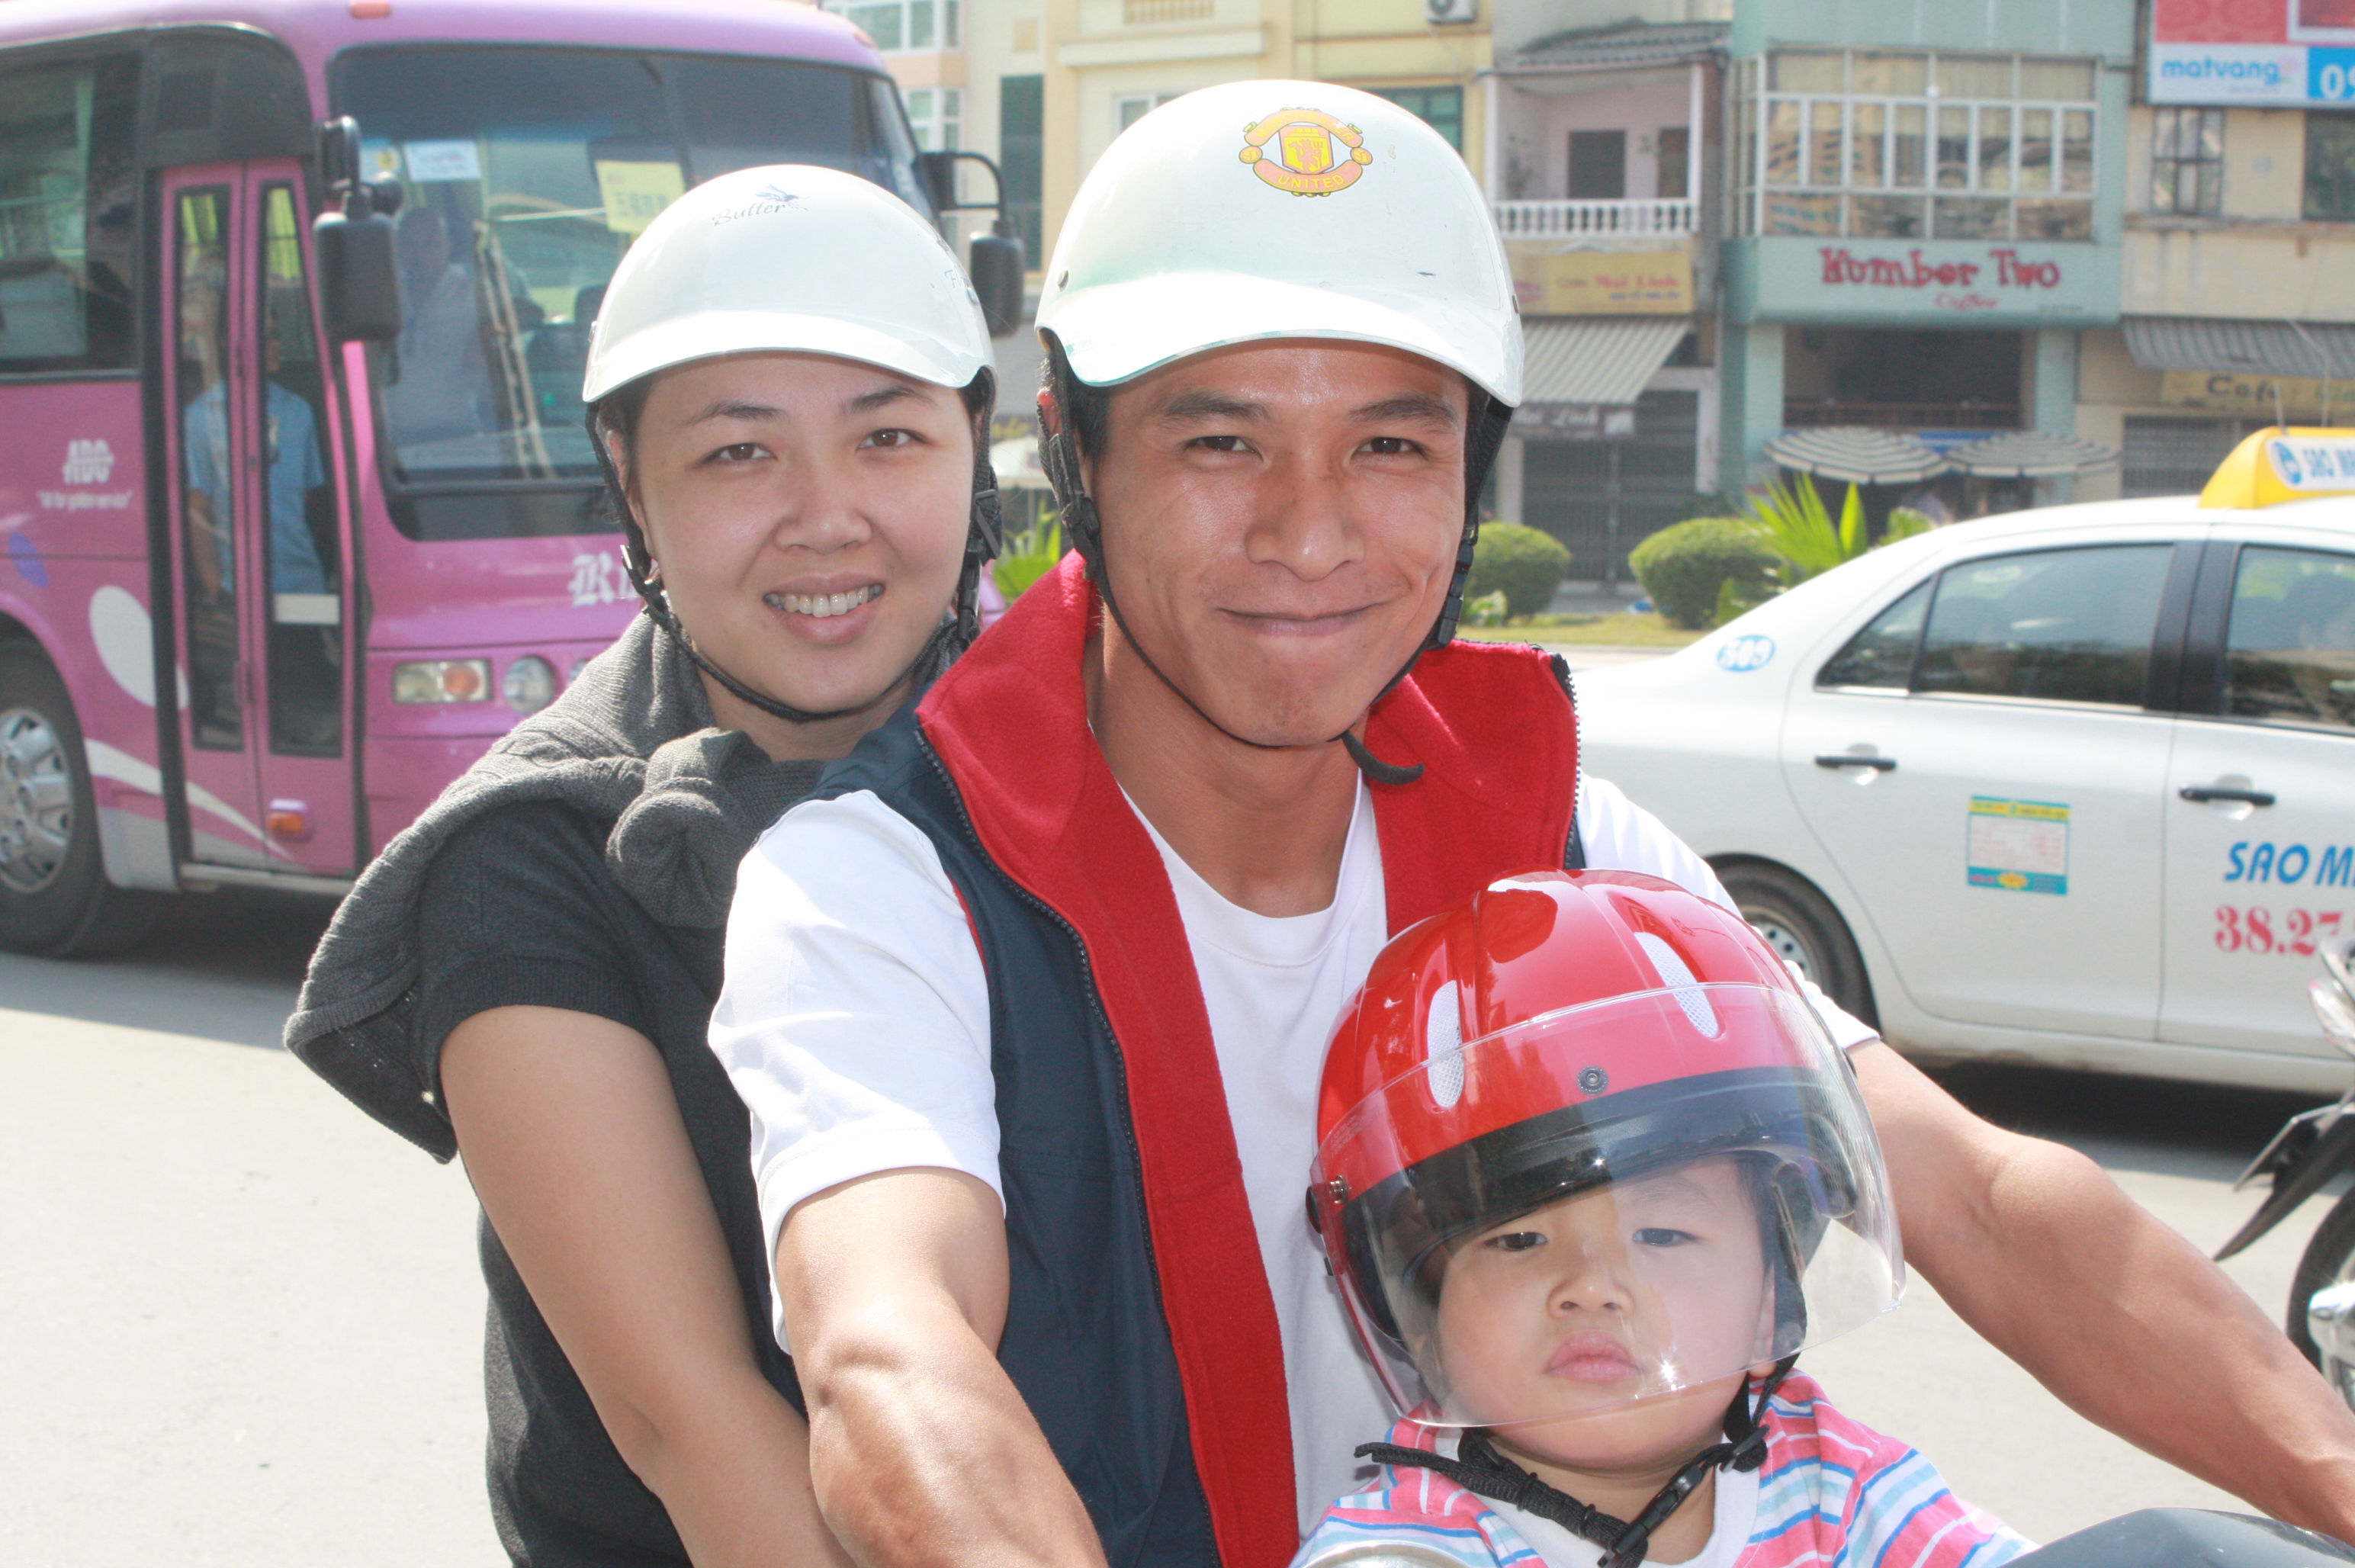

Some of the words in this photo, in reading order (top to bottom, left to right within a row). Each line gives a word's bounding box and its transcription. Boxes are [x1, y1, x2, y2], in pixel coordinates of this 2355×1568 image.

[2161, 55, 2279, 85] matvang
[1255, 113, 1355, 141] MANCHESTER
[1277, 174, 1345, 189] UNITED
[712, 201, 786, 227] Butter
[1820, 247, 1979, 288] Number
[1989, 249, 2061, 288] Two
[2224, 841, 2310, 885] SAO
[2314, 844, 2355, 887] M
